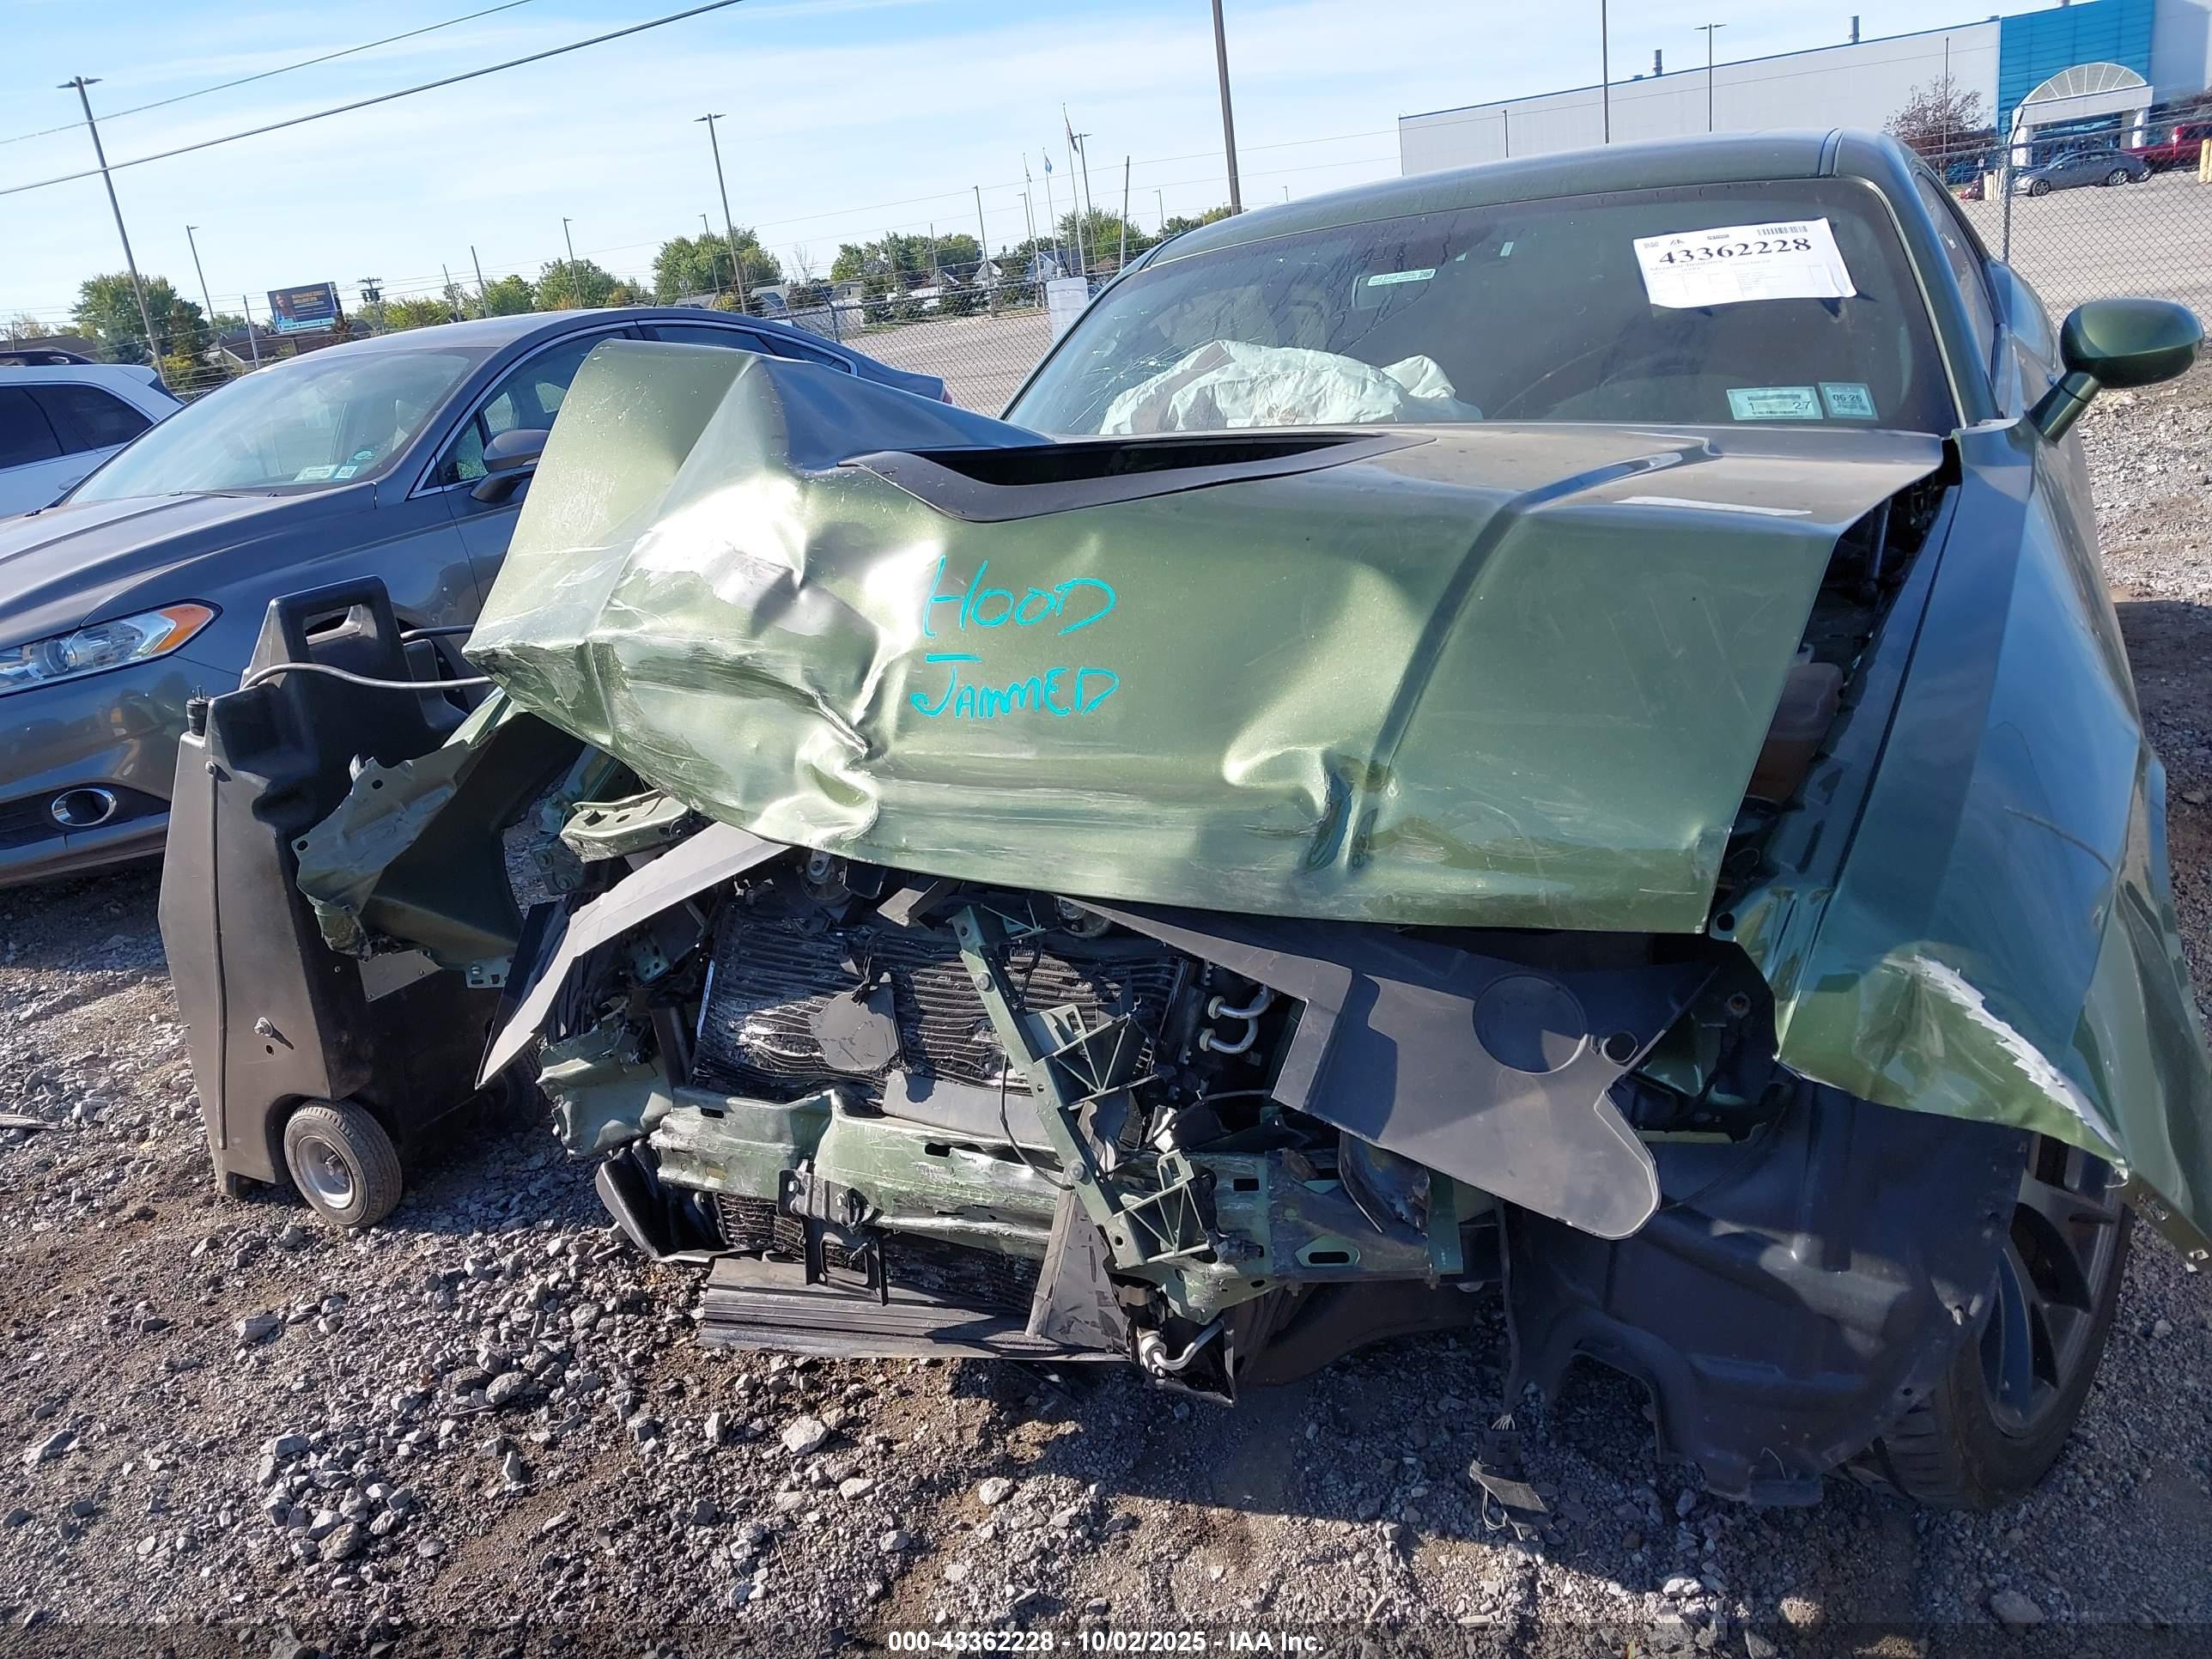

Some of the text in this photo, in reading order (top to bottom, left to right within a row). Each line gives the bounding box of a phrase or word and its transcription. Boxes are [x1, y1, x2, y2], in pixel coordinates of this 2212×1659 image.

[1659, 238, 1812, 264] 43362228
[1792, 400, 1813, 410] 27
[922, 554, 1117, 640] HOOD
[909, 652, 1121, 721] JAMMED
